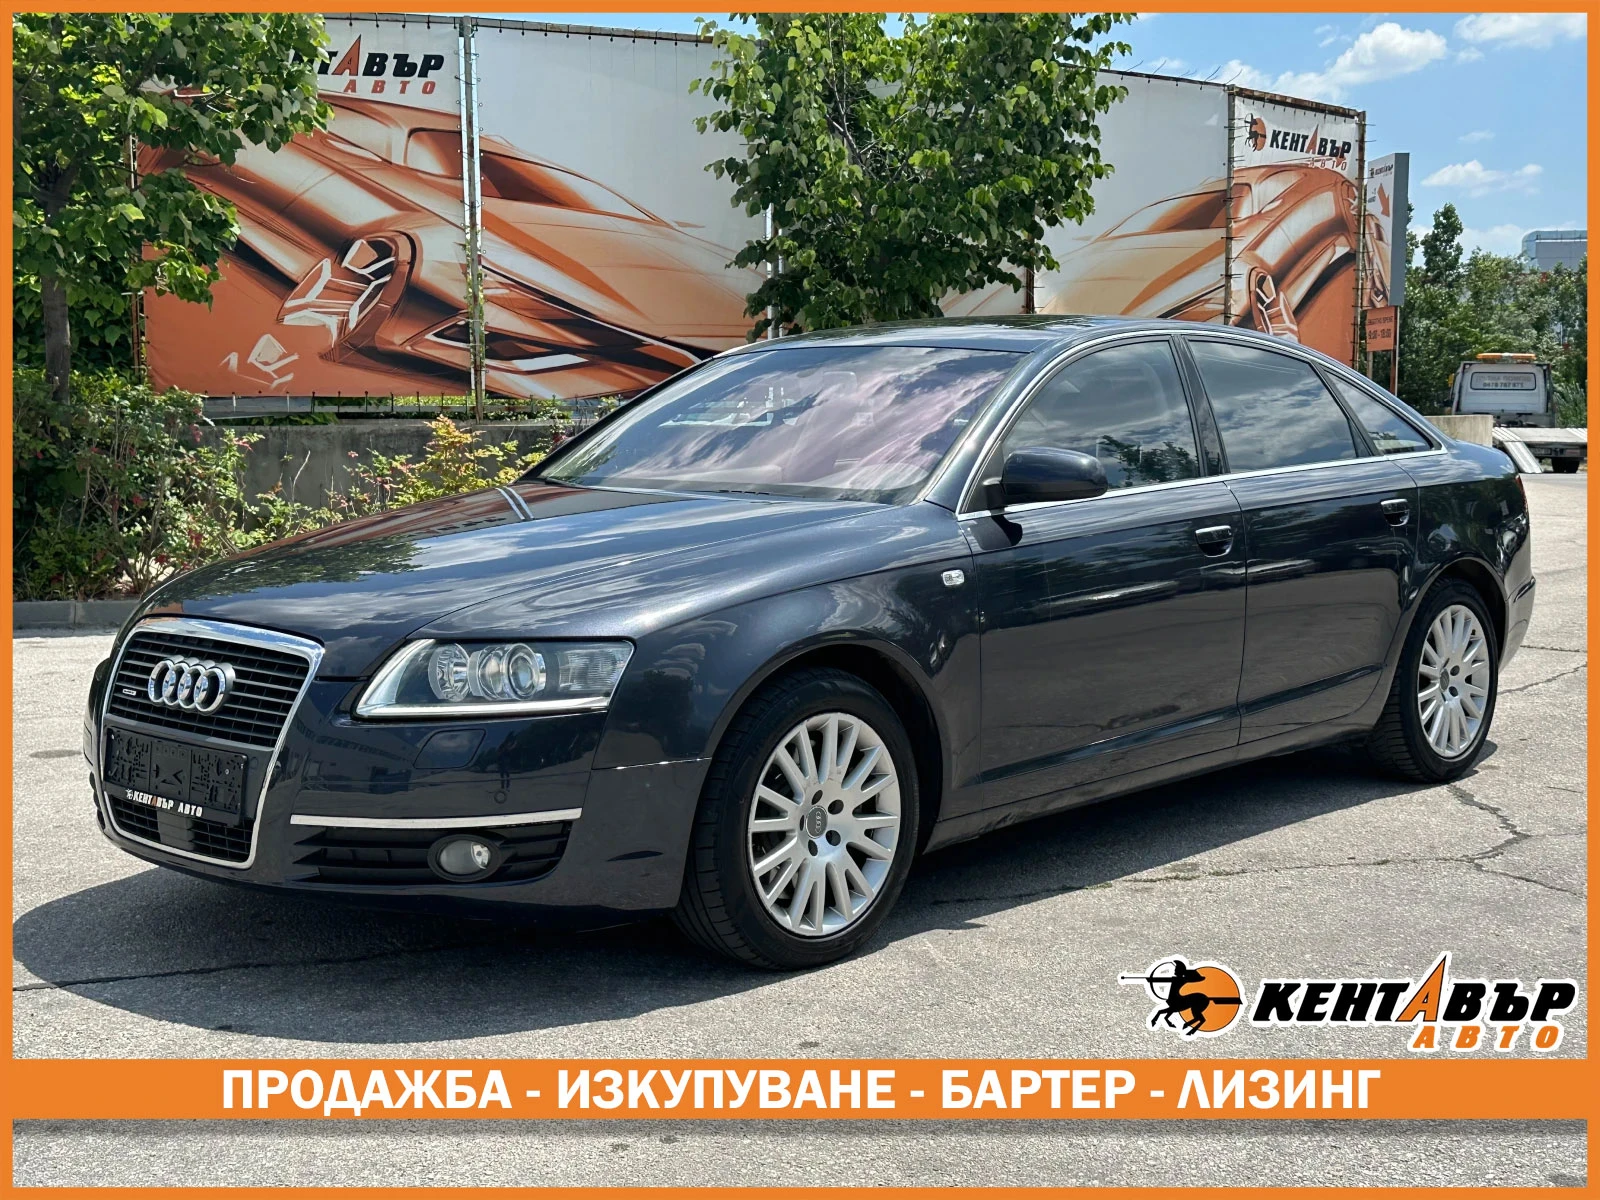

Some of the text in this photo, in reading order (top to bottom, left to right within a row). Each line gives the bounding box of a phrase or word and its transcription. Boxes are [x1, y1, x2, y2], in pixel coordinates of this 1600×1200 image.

[292, 34, 444, 77] ТАВЪР
[344, 79, 436, 95] АВТО
[1269, 124, 1352, 158] КЕНТАВЪР
[133, 790, 203, 817] КЕНТАВЪР АВТО
